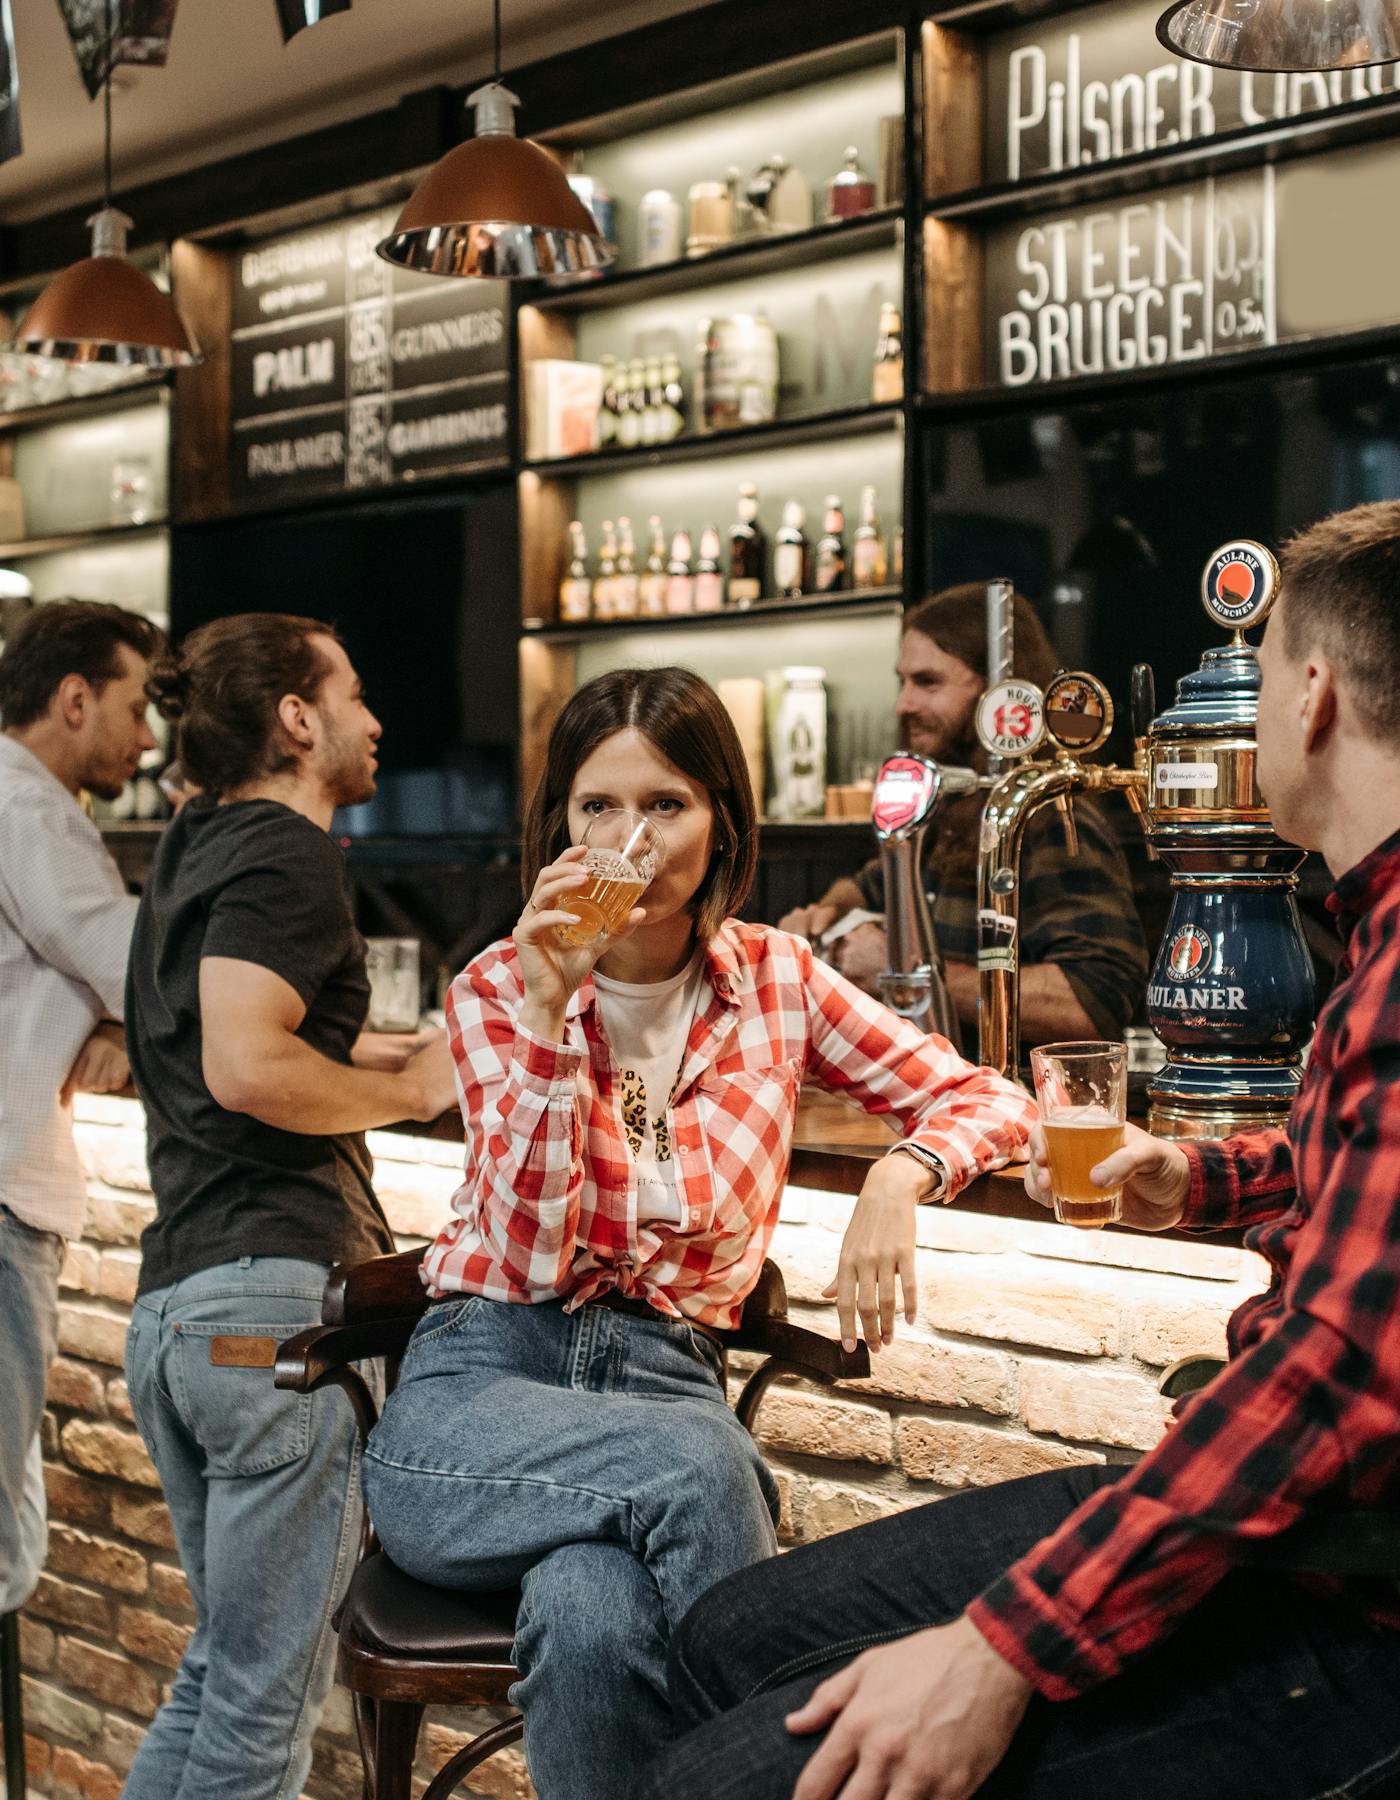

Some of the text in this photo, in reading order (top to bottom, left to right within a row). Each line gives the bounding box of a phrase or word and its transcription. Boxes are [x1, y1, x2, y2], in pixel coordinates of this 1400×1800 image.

[1016, 194, 1197, 311] STEEN
[1001, 280, 1206, 387] BRUGGE
[253, 337, 335, 397] PALM
[994, 703, 1034, 737] 13
[1007, 688, 1041, 717] HOUSE
[993, 734, 1031, 749] LAGER
